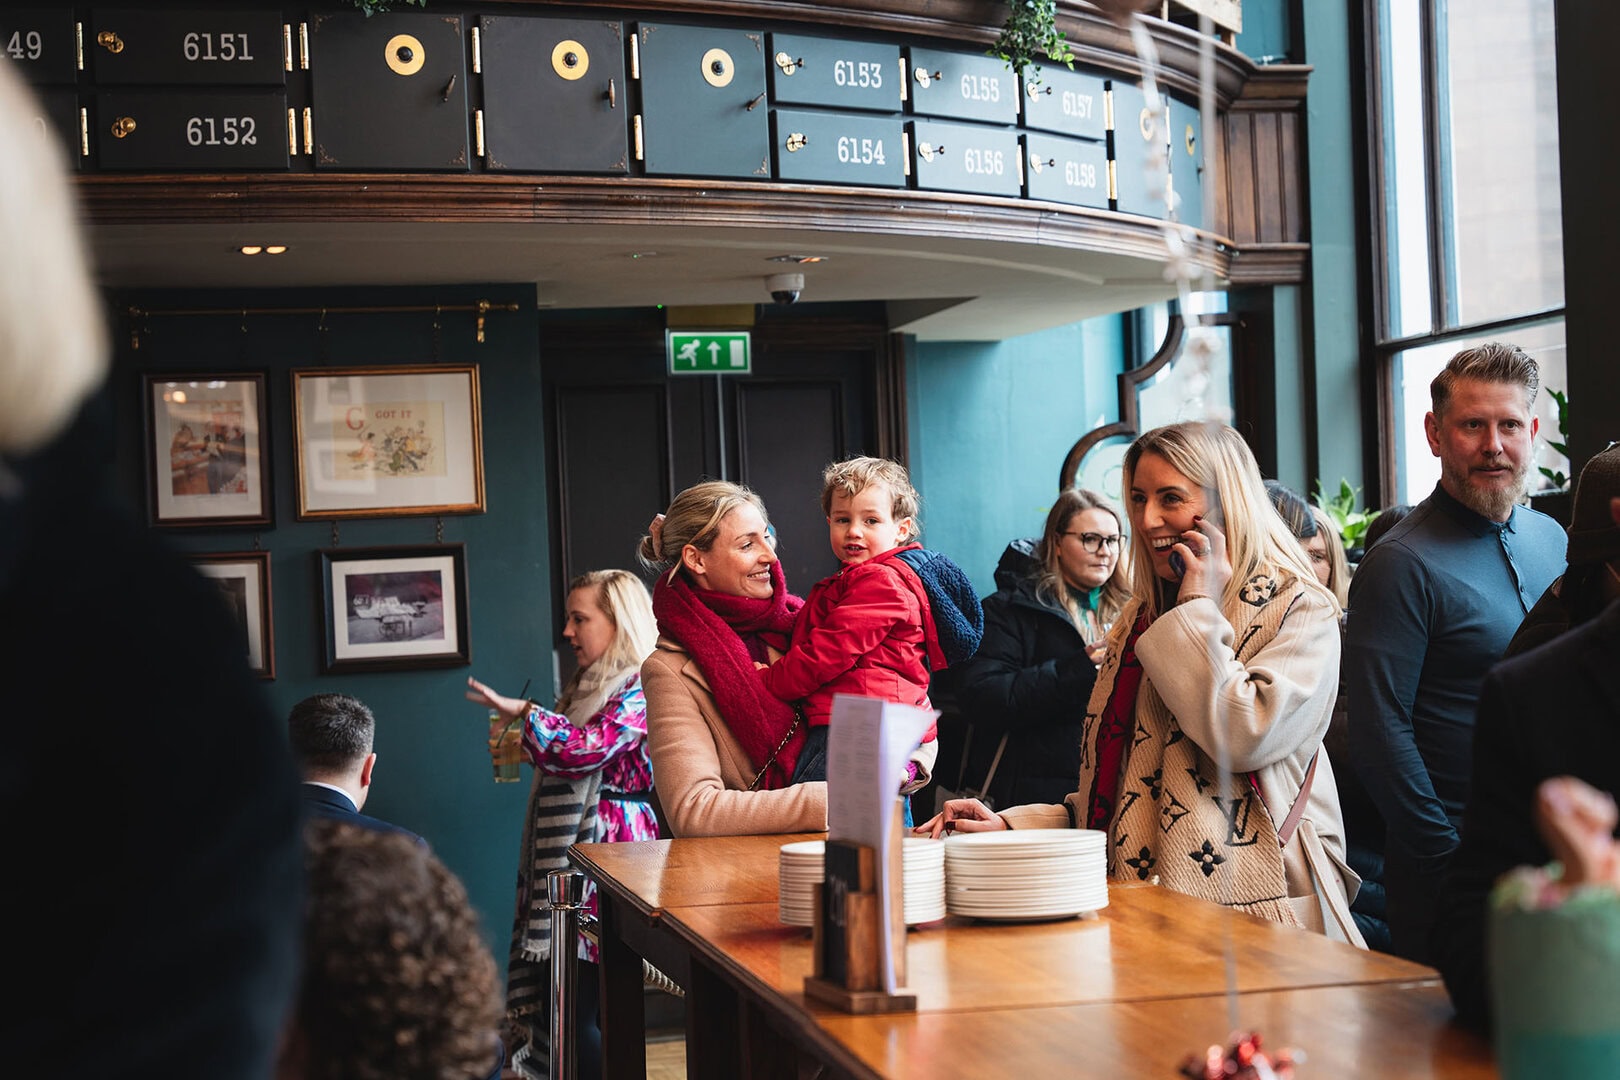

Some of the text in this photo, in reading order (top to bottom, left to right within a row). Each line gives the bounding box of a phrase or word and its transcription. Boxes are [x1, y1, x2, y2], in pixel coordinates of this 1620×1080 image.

[0, 31, 42, 60] 49
[183, 32, 254, 62] 6151
[834, 59, 883, 89] 6153
[961, 74, 1000, 103] 6155
[1062, 90, 1093, 119] 6157
[186, 117, 257, 146] 6152
[837, 136, 886, 166] 6154
[964, 148, 1004, 176] 6156
[1065, 160, 1097, 189] 6158
[375, 410, 396, 420] GOT
[401, 410, 413, 419] IT
